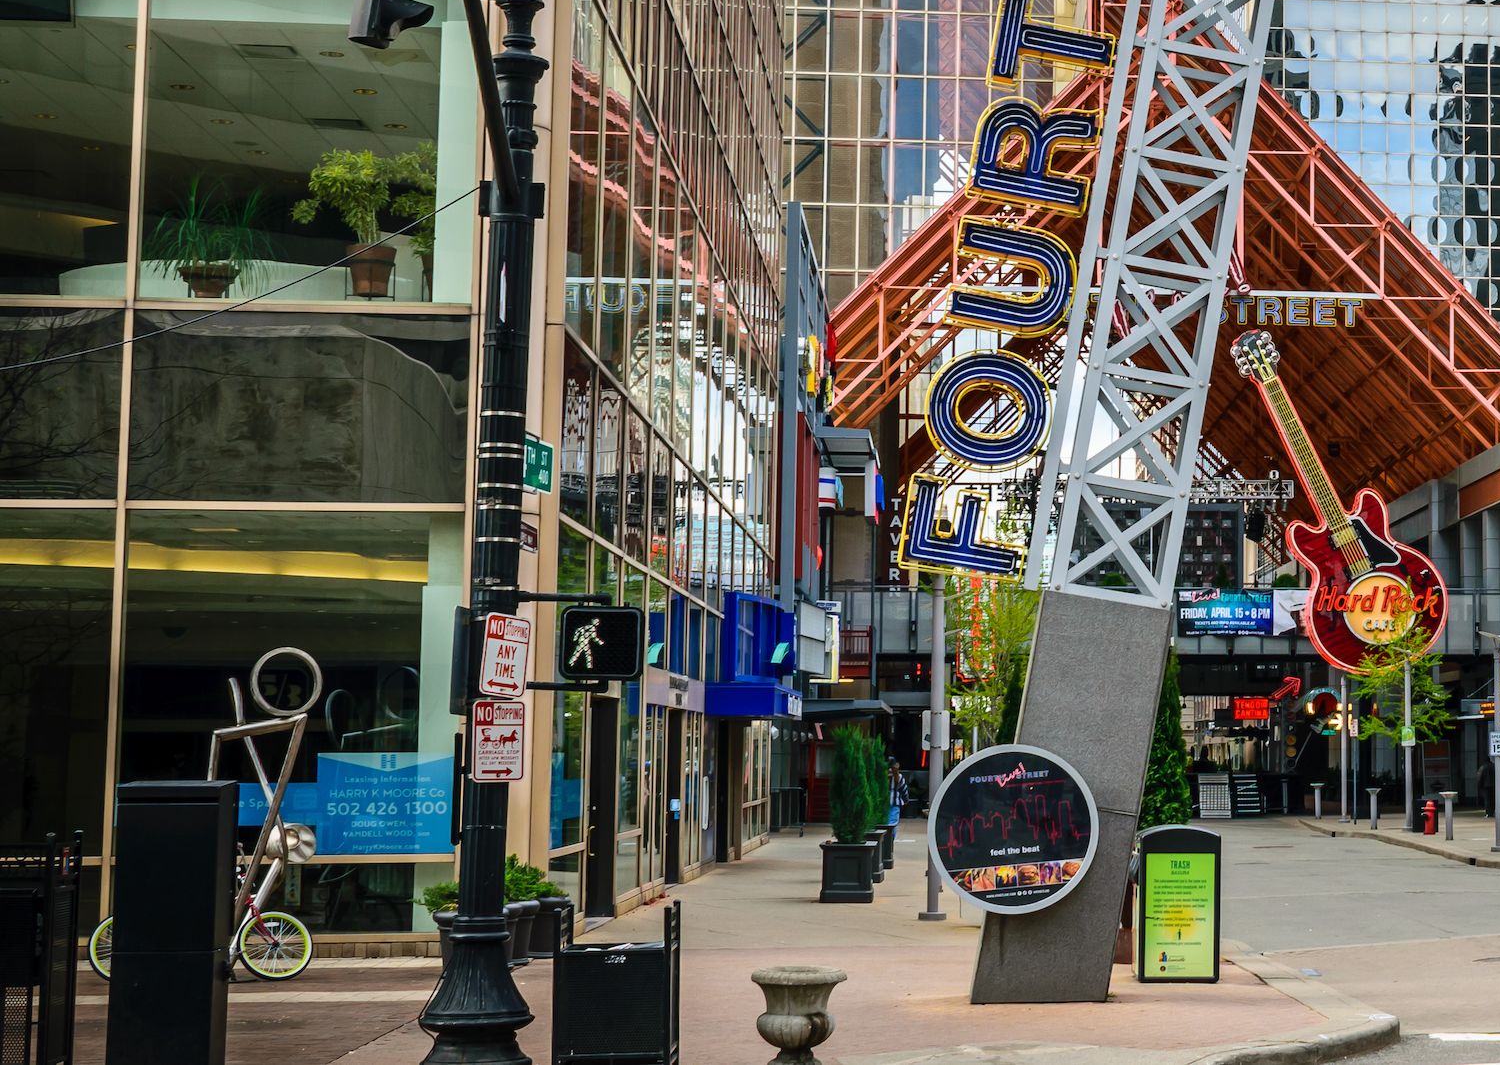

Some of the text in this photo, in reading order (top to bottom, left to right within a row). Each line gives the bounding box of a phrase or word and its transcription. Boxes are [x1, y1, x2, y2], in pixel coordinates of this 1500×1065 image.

[541, 451, 548, 466] ST
[538, 469, 549, 485] 400
[1191, 588, 1220, 603] Live!
[1221, 593, 1247, 602] FOURTH
[1248, 594, 1271, 603] STREET
[1317, 585, 1440, 617] Hard Rock
[1181, 607, 1270, 619] FRIDAY, APRIL 15 8 PM
[490, 620, 528, 639] NO STOPPING
[1363, 619, 1395, 632] CAFE
[497, 645, 517, 659] ANY
[494, 663, 516, 679] TIME
[477, 707, 522, 721] NO STOPPING
[345, 776, 378, 784] Leasing
[330, 788, 445, 798] HARRY K MOORE Co
[327, 801, 447, 815] 502 426 1300
[990, 848, 1006, 856] feel
[1022, 845, 1040, 853] beat
[1170, 860, 1190, 869] TRASH
